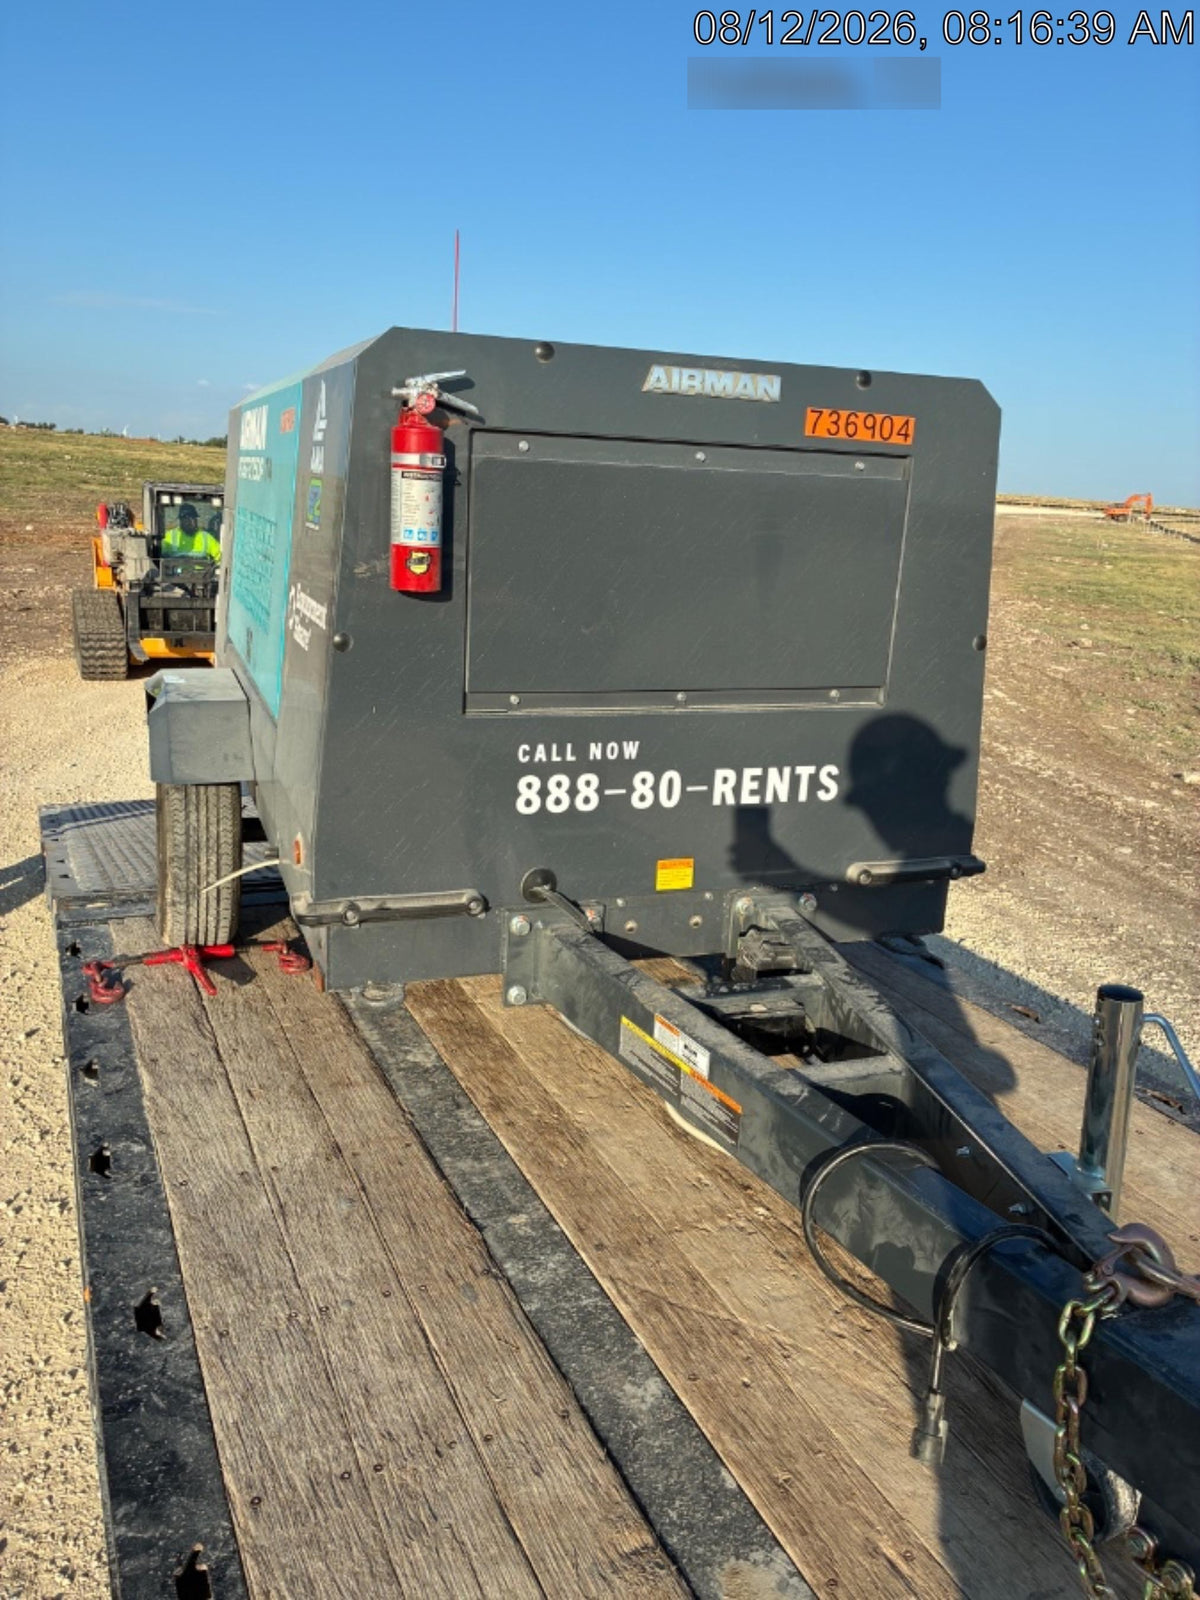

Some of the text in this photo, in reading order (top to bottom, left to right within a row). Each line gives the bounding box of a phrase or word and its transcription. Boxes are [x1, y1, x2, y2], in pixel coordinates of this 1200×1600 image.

[642, 364, 782, 402] AIRMAN
[809, 408, 911, 442] 736904
[517, 740, 641, 764] CALL NOW
[515, 763, 840, 815] 888-80-RENTS
